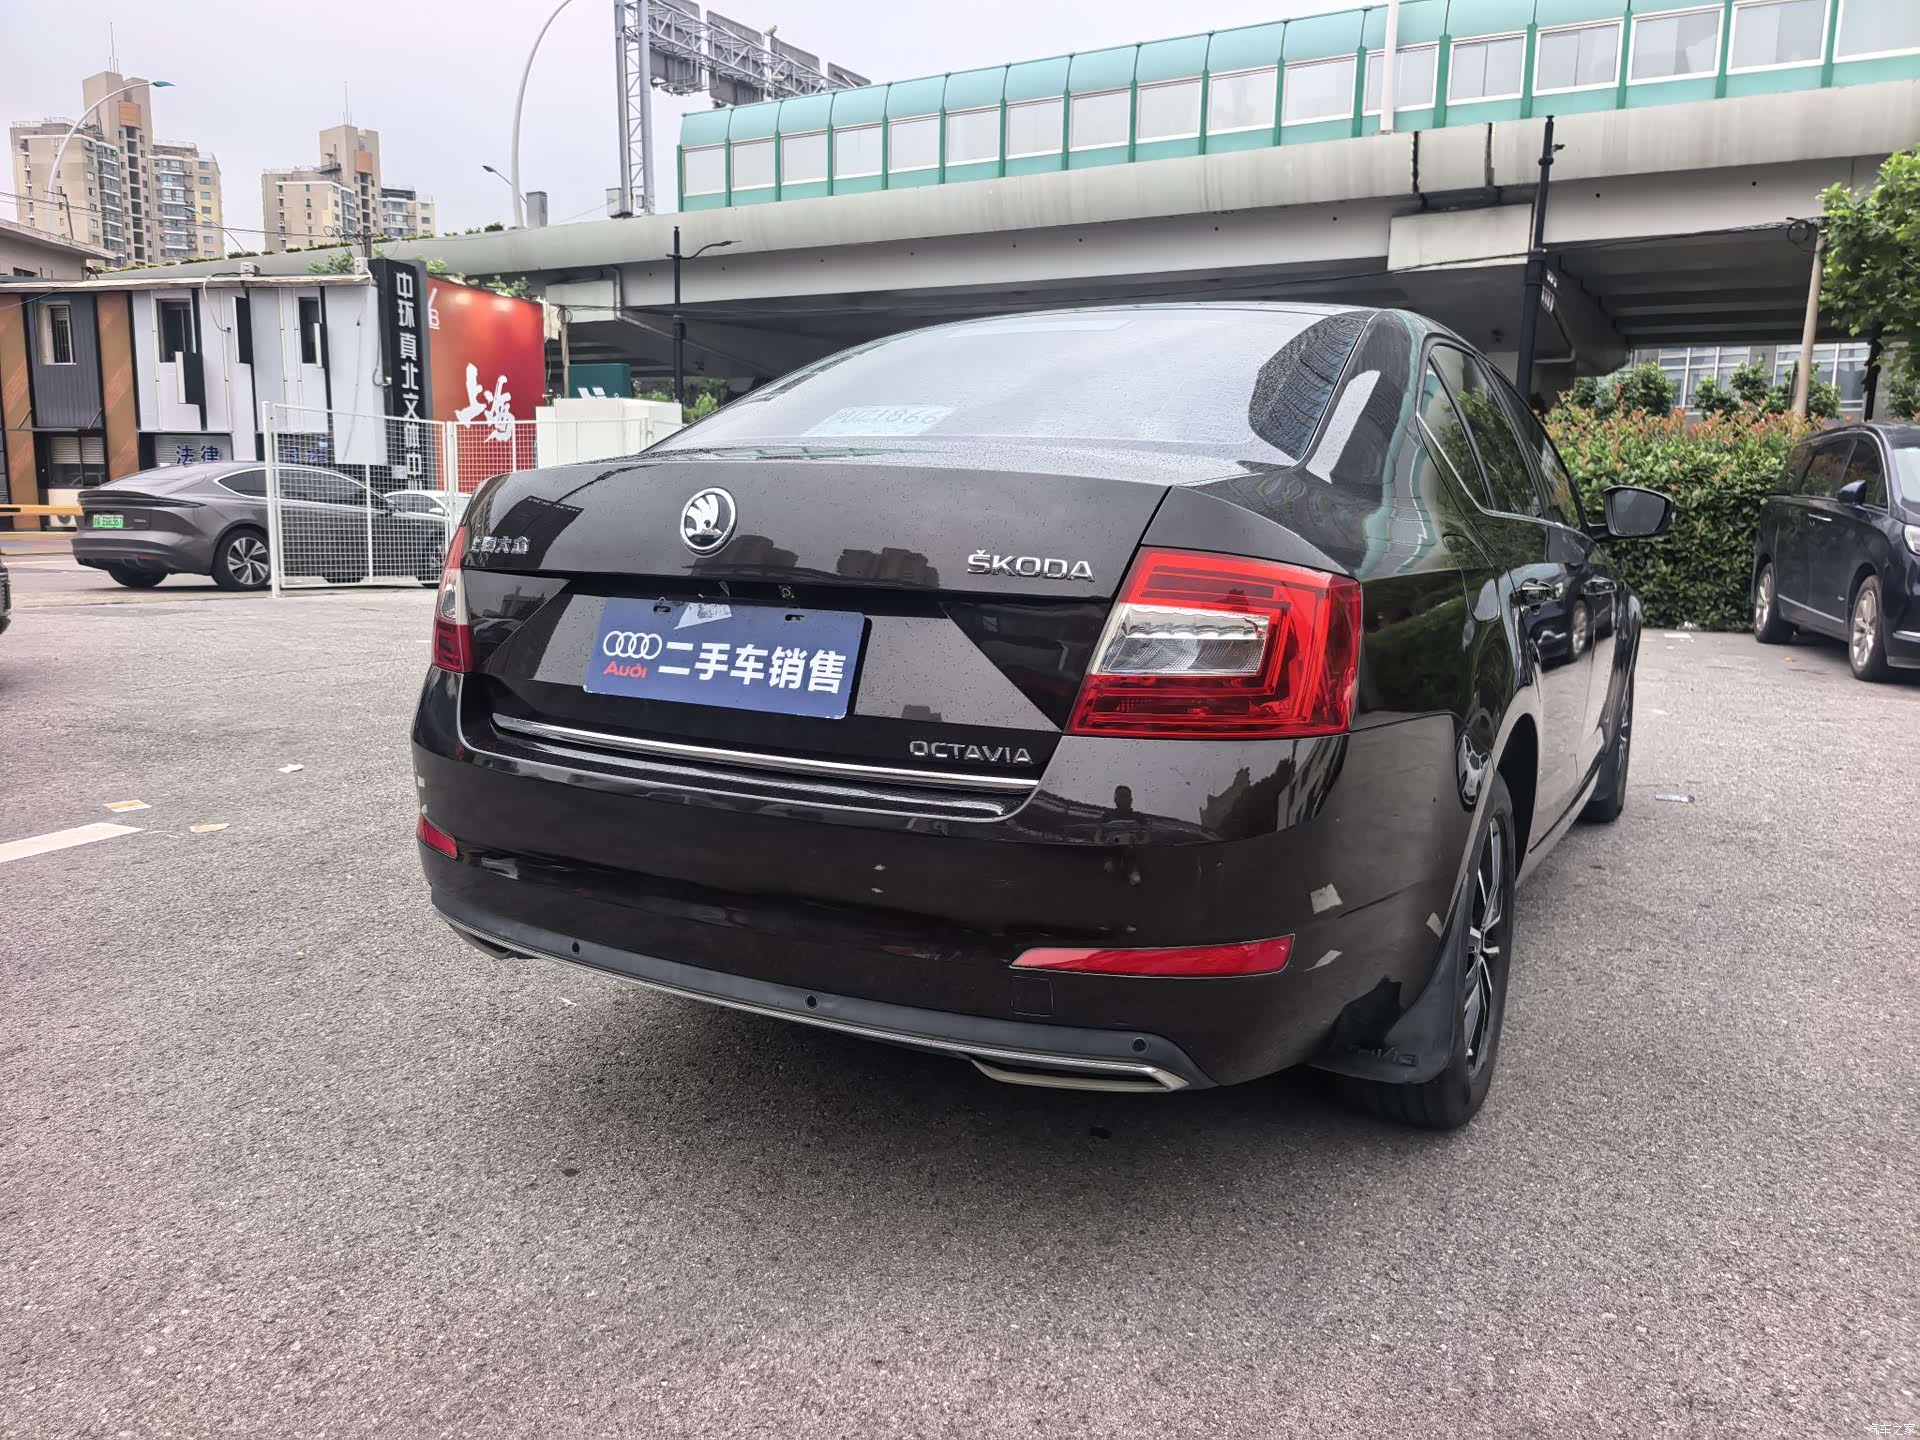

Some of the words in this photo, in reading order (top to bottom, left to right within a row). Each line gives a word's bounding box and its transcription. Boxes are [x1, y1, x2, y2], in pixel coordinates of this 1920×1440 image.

[455, 363, 515, 442] 上海
[176, 445, 219, 464] 法律
[967, 549, 1095, 583] ŠKODA
[602, 660, 648, 679] Audi
[658, 641, 847, 694] 二手车销售
[909, 740, 1034, 765] OCTAVIA
